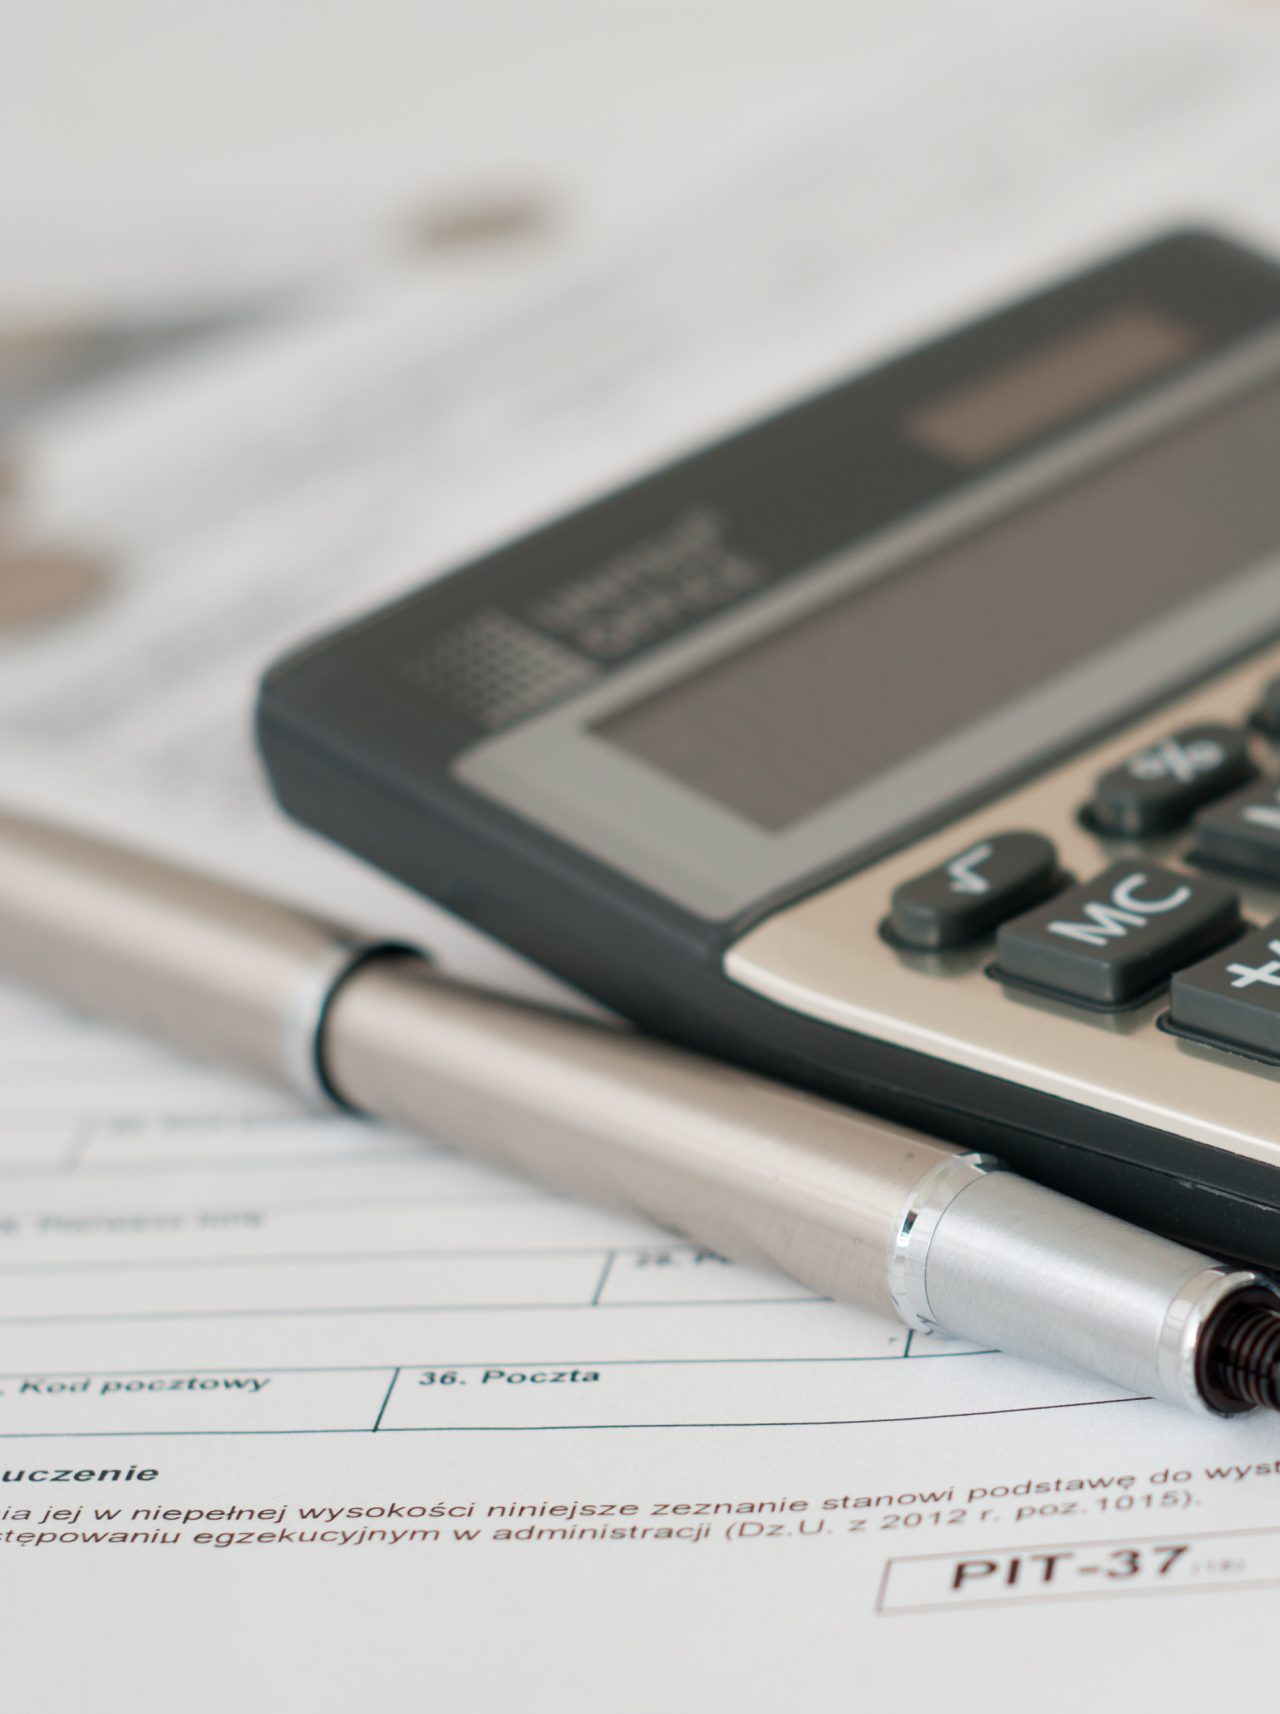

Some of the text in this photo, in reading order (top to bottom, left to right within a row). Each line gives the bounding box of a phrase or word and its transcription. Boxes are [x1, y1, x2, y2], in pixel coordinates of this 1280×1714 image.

[1047, 873, 1190, 946] MC
[19, 1376, 271, 1396] Kod pocztowy
[417, 1368, 601, 1387] 36. Poczta
[1, 1465, 160, 1483] uczenie
[38, 1505, 84, 1525] jej
[95, 1508, 122, 1521] w
[131, 1504, 288, 1525] niepełnej
[299, 1502, 475, 1524] wysokości
[487, 1500, 640, 1521] niniejsze
[650, 1496, 809, 1516] zeznanie
[822, 1486, 954, 1512] stanowi
[966, 1471, 1136, 1504] podstawę
[1150, 1466, 1192, 1485] do
[193, 1526, 440, 1549] egzekucyjnym
[453, 1528, 481, 1542] w
[492, 1521, 711, 1545] administracji
[725, 1518, 833, 1543] (Dz.U.
[848, 1519, 867, 1533] z
[880, 1507, 967, 1531] 2012
[980, 1506, 1001, 1523] r.
[949, 1543, 1192, 1592] PIT-37
